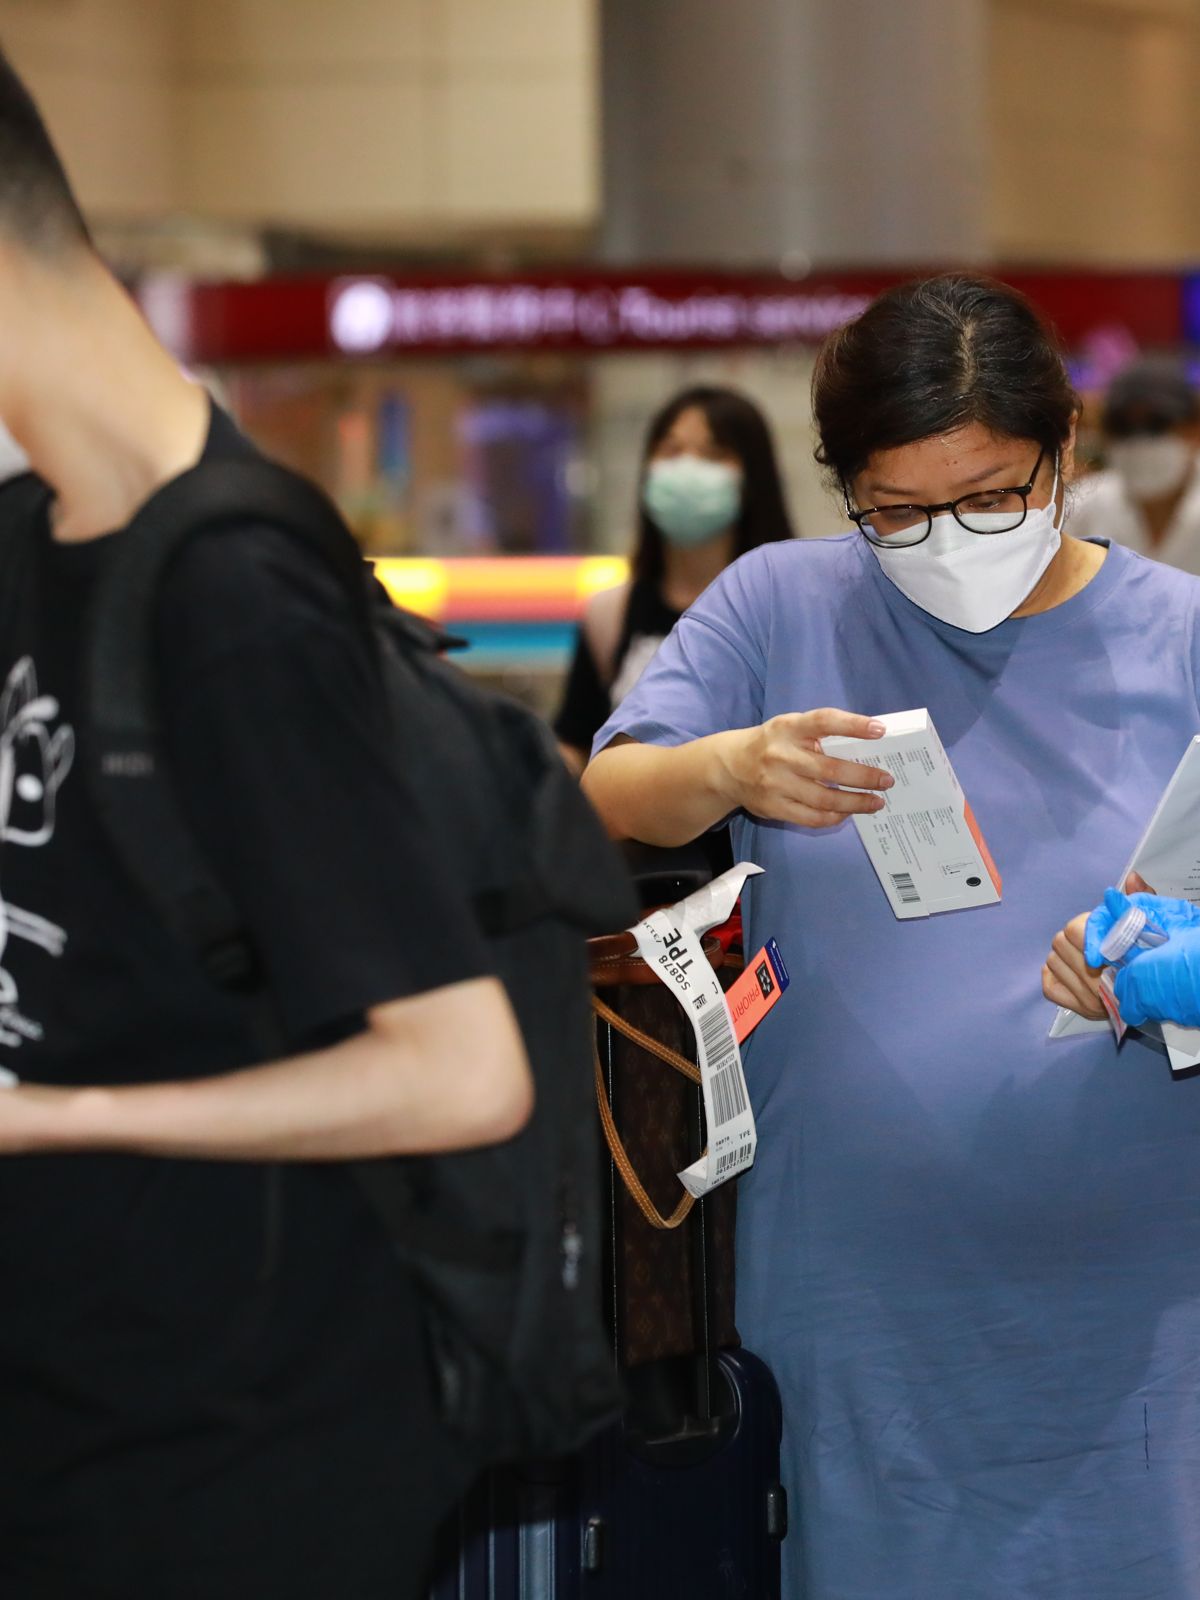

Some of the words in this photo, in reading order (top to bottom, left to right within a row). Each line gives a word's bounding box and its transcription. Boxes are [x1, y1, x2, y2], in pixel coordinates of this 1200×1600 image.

[662, 928, 694, 975] TPE
[659, 955, 691, 991] SQ878
[733, 985, 759, 1023] PRIORIT
[739, 1129, 751, 1140] TPE
